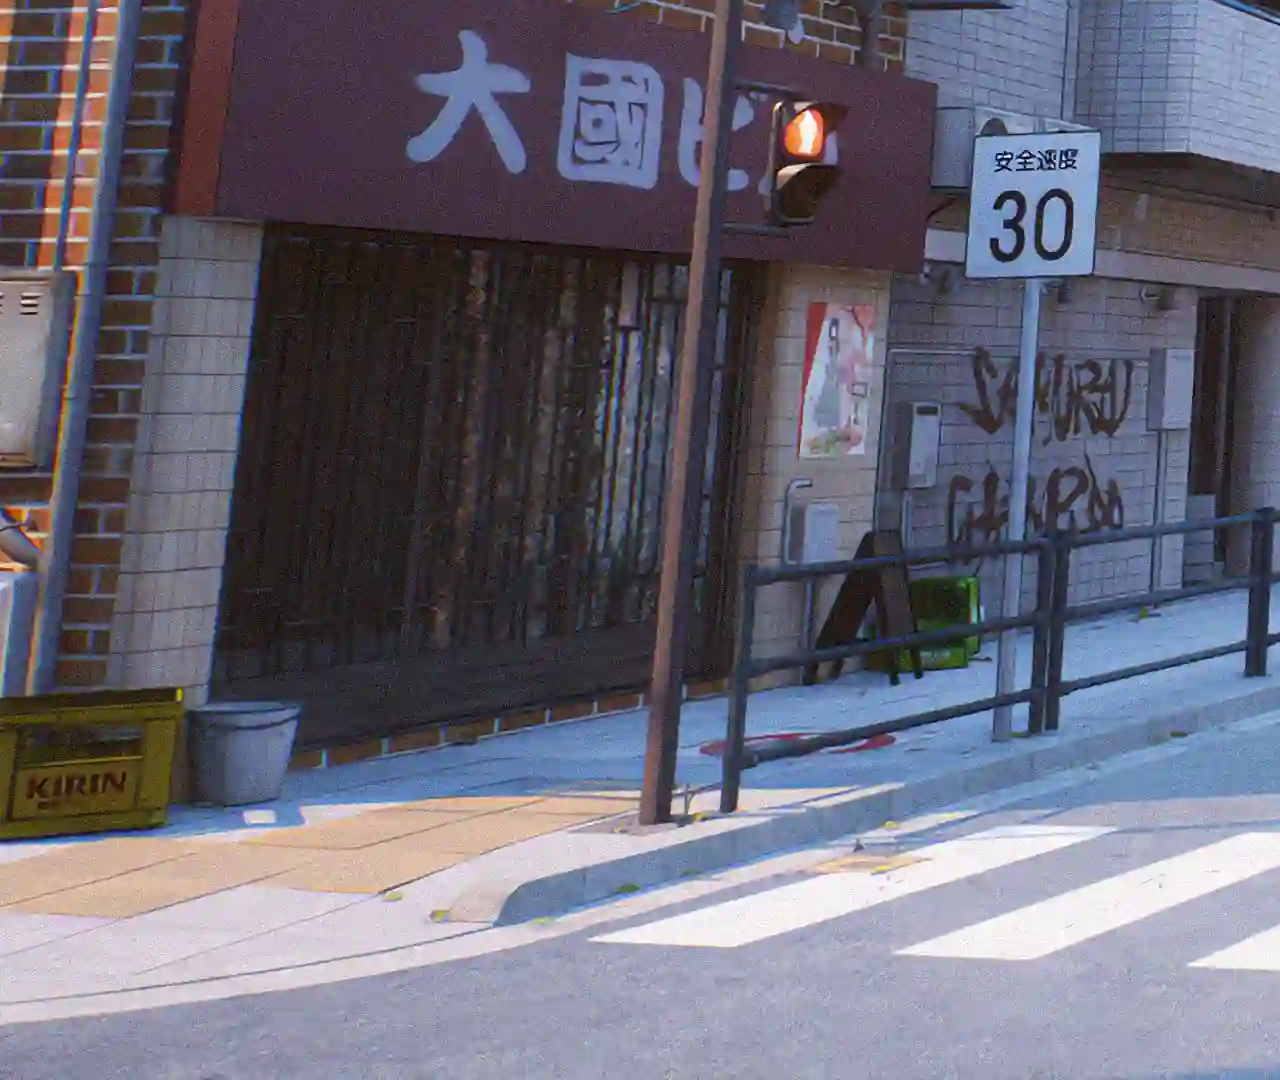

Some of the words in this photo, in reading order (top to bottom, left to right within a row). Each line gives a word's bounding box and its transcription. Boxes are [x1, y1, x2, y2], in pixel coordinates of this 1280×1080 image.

[405, 29, 838, 196] 大國ビ
[993, 148, 1079, 173] 安全速度
[989, 188, 1075, 263] 30
[26, 771, 128, 800] KIRIN
